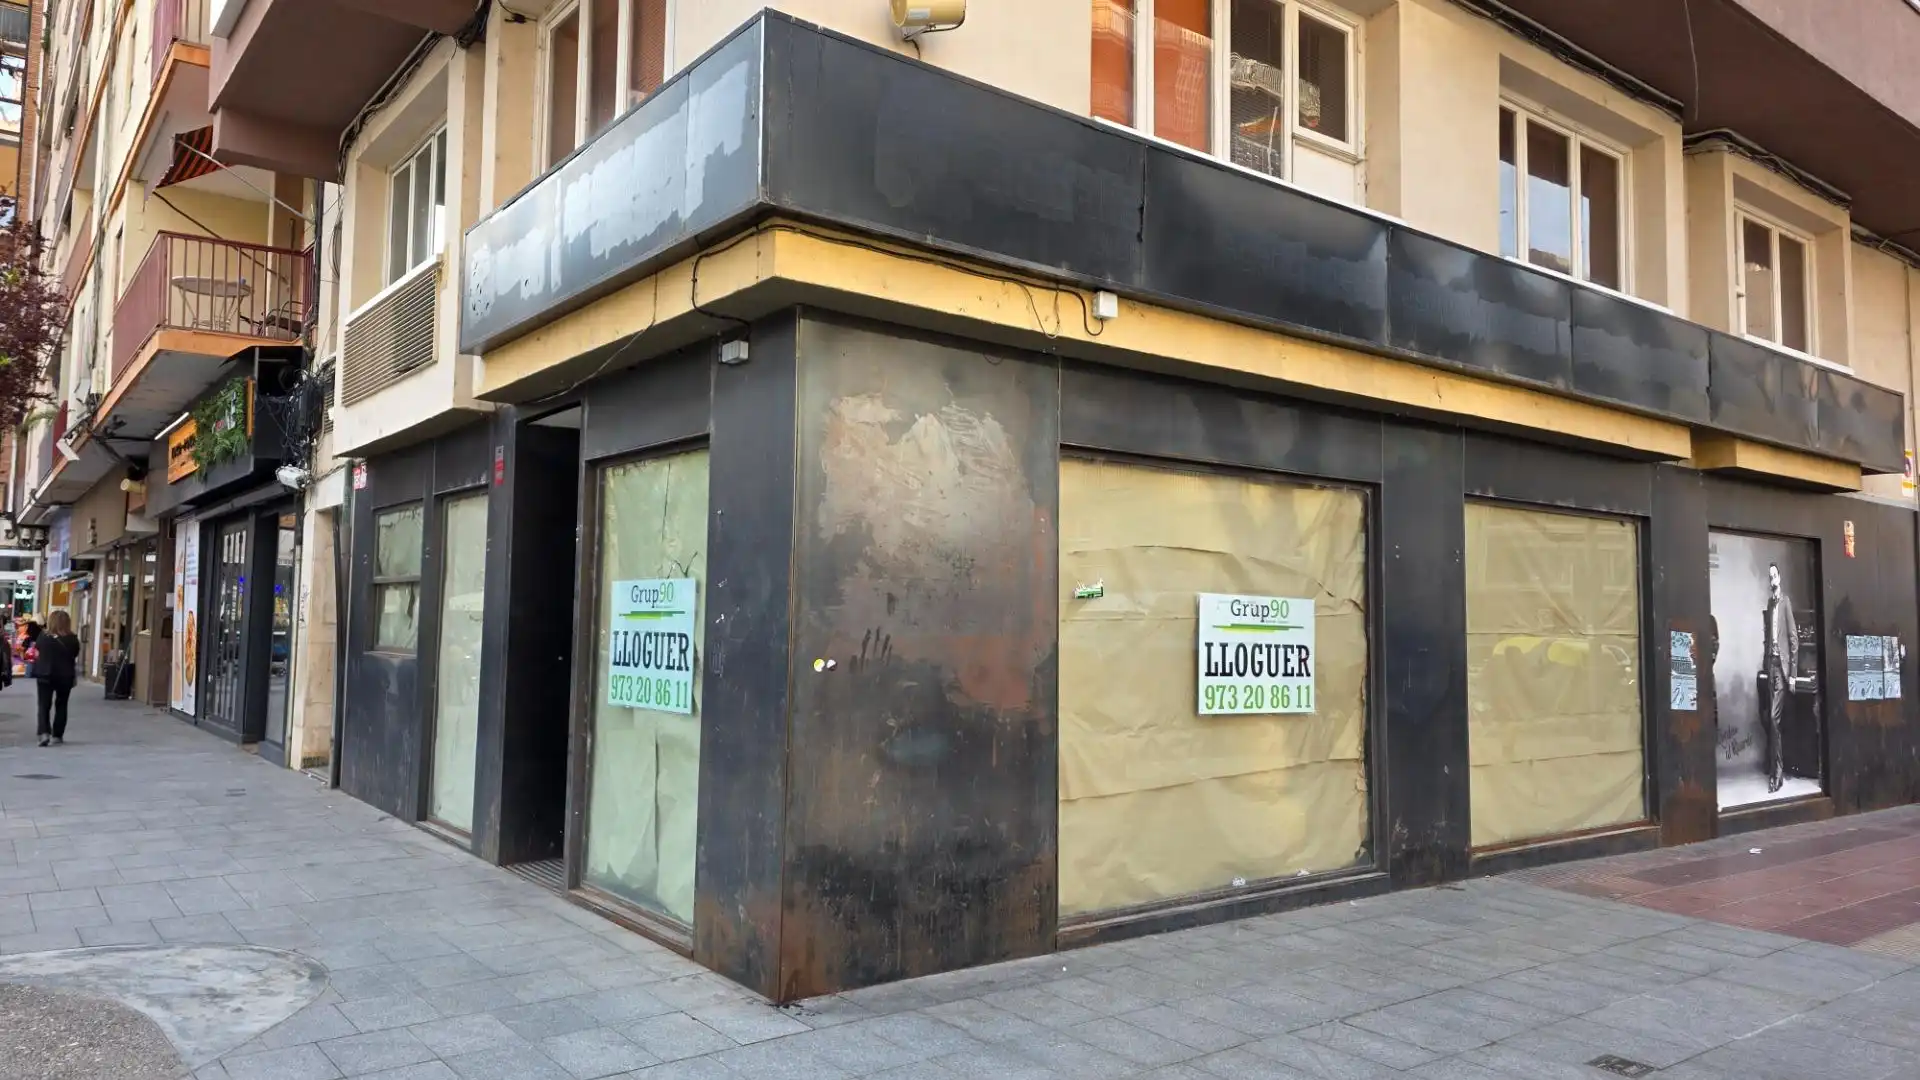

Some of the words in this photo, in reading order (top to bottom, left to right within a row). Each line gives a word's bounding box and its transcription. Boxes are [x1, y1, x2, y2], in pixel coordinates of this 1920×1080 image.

[631, 582, 674, 608] Grup90
[1230, 599, 1289, 622] Grup90
[612, 630, 690, 672] LLOGUER
[1204, 642, 1311, 678] LLOGUER
[611, 674, 633, 702] 973
[636, 676, 652, 704] 20
[655, 678, 671, 706] 86
[675, 680, 688, 709] 11
[1204, 684, 1238, 710] 973
[1243, 684, 1265, 709] 20
[1270, 684, 1290, 709] 86
[1296, 684, 1311, 708] 11
